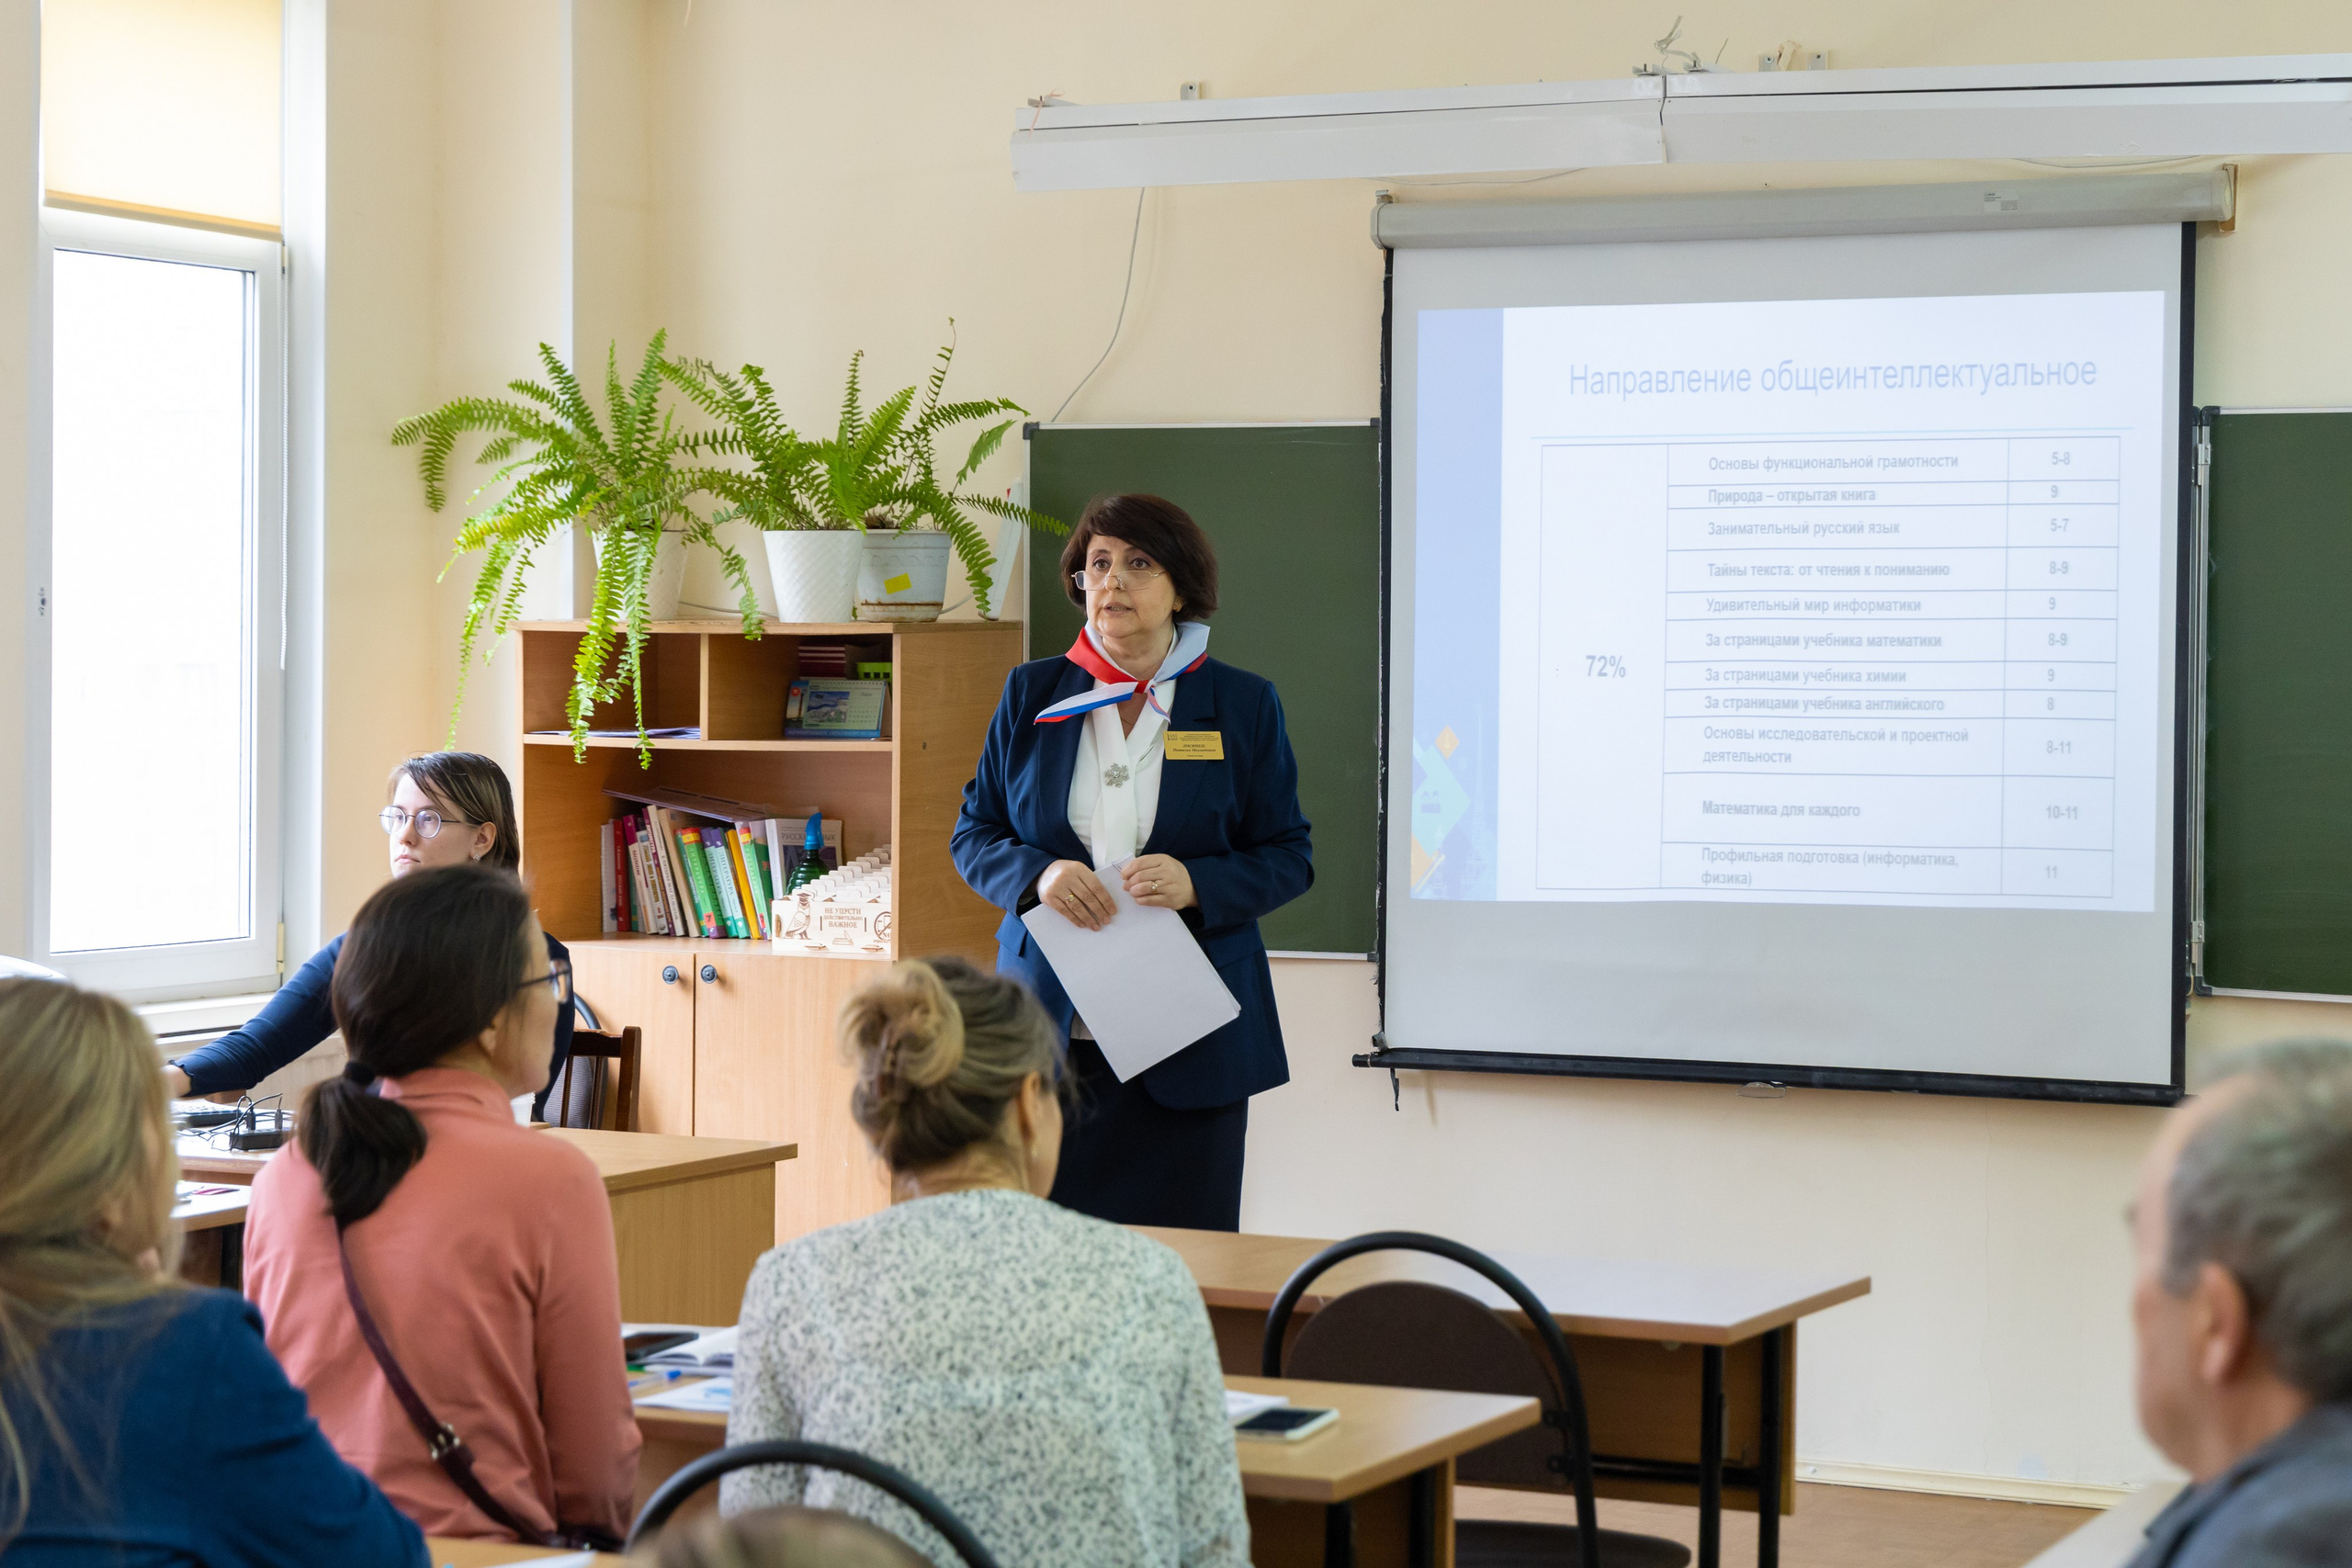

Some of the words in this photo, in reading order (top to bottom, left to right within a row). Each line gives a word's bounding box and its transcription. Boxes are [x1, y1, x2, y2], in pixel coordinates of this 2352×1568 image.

[1569, 363, 1752, 401] Направление
[1760, 358, 2098, 396] общеинтеллектуальное
[1709, 457, 1759, 470] Основы
[1763, 456, 1873, 473] функциональной
[1877, 456, 1959, 470] грамотности
[2052, 451, 2070, 466] 5-8
[1708, 489, 1763, 505] Природа
[1777, 489, 1838, 504] открытая
[1840, 489, 1876, 502] книга
[2051, 485, 2058, 498] 9
[1708, 520, 1809, 536] Занимательный
[1814, 520, 1864, 537] русский
[1868, 522, 1900, 535] язык
[2051, 518, 2069, 532] 5-7
[1707, 563, 1747, 577] Тайны
[1750, 564, 1794, 577] текста:
[1798, 565, 1812, 576] от
[1816, 564, 1860, 577] чтения
[1863, 565, 1871, 576] к
[1874, 564, 1950, 577] пониманию
[2049, 560, 2068, 574] 8-9
[1706, 597, 1800, 614] Удивительный
[1804, 599, 1828, 615] мир
[1833, 598, 1921, 615] информатики
[2049, 597, 2056, 610] 9
[1705, 633, 1721, 647] За
[1724, 634, 1800, 649] страницами
[1803, 632, 1862, 649] учебника
[1866, 634, 1942, 647] математики
[2048, 633, 2067, 647] 8-9
[1585, 655, 1626, 678] 72%
[1705, 668, 1720, 682] За
[1723, 669, 1799, 683] страницами
[1803, 668, 1862, 685] учебника
[1865, 670, 1906, 682] химии
[2047, 668, 2054, 682] 9
[1704, 695, 1719, 709] За
[1723, 696, 1799, 712] страницами
[1802, 696, 1861, 713] учебника
[1865, 697, 1944, 712] английского
[2047, 696, 2054, 711] 8
[1703, 726, 1754, 739] Основы
[1758, 727, 1886, 744] исследовательской
[1889, 730, 1897, 741] и
[1901, 728, 1969, 745] проектной
[2046, 740, 2072, 754] 8-11
[1702, 749, 1792, 763] деятельности
[1702, 800, 1778, 815] Математика
[1780, 804, 1804, 818] для
[1808, 804, 1860, 818] каждого
[2045, 805, 2078, 819] 10-11
[1702, 846, 1783, 864] Профильная
[1787, 849, 1860, 865] подготовка
[1862, 850, 1959, 868] (информатика,
[1701, 871, 1752, 887] физика)
[2045, 865, 2058, 879] 11
[829, 920, 857, 929] ВАЖНОЕ
